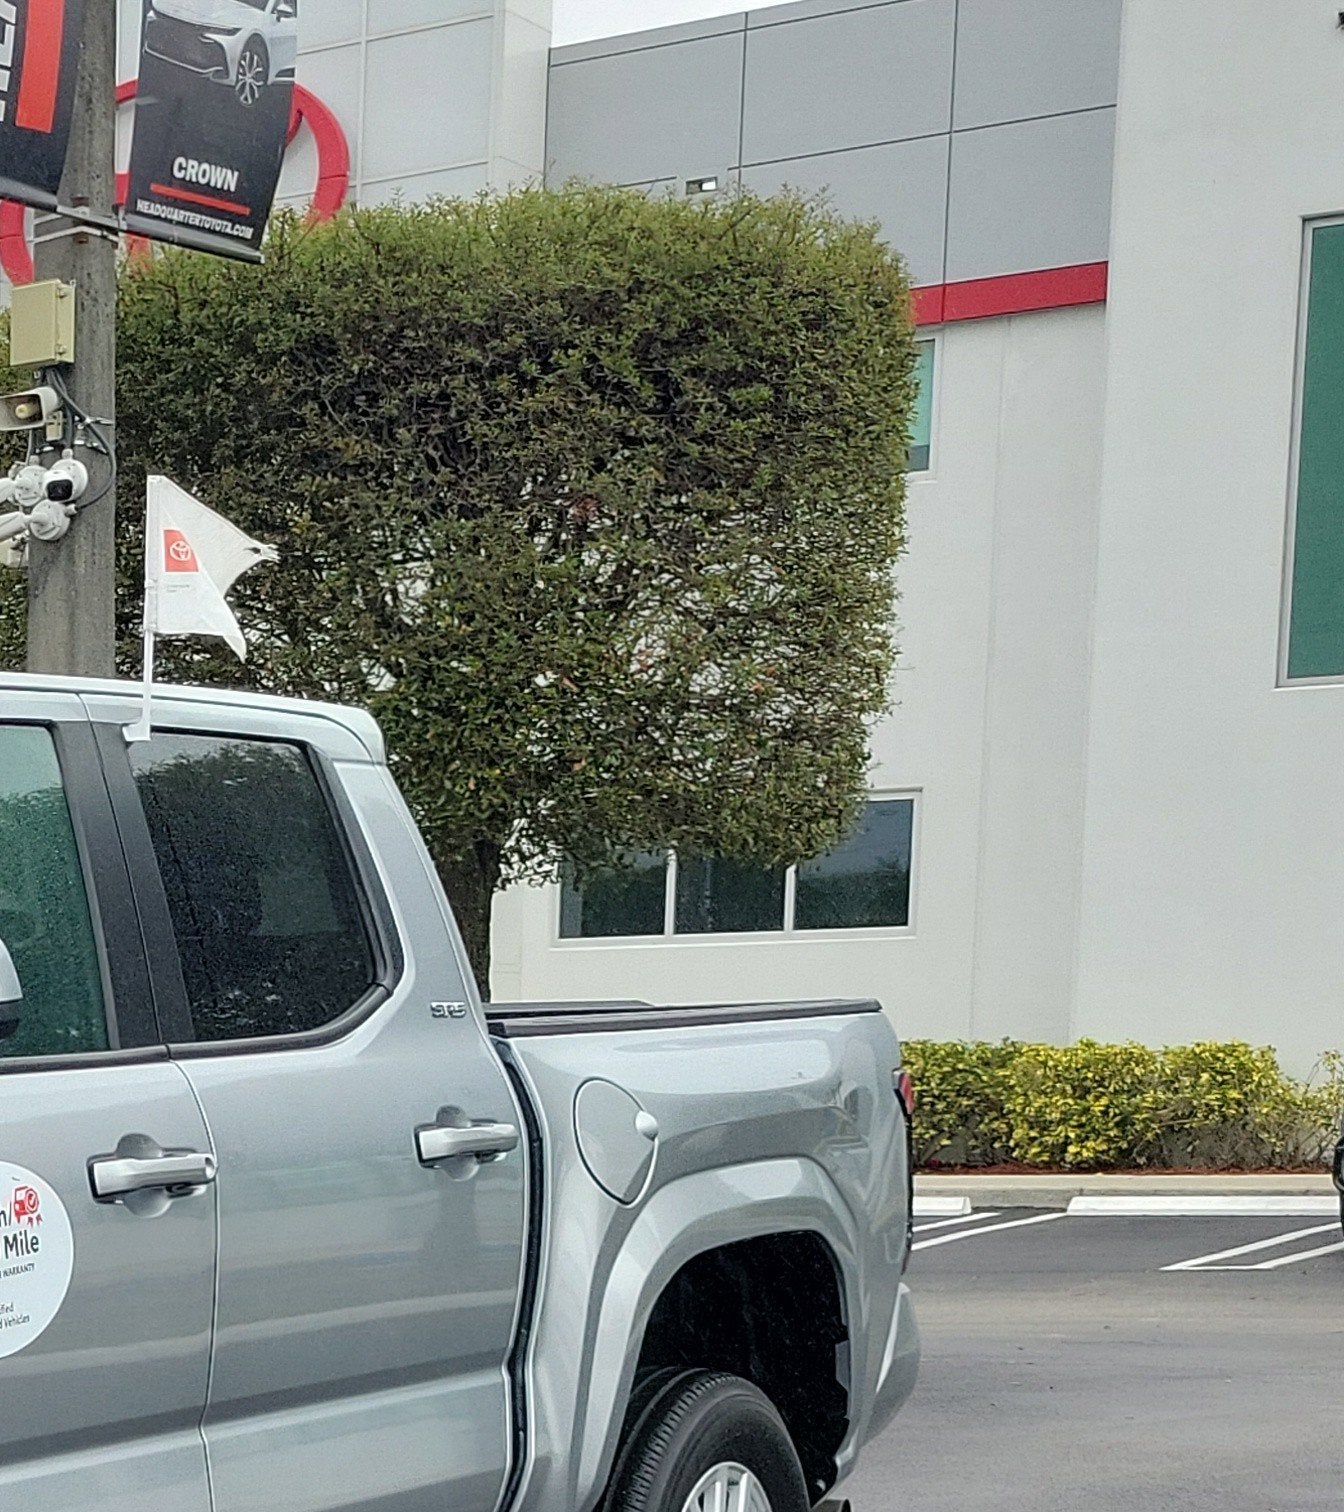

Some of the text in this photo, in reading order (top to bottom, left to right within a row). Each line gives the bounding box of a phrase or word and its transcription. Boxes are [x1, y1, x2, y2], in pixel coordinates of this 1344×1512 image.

[172, 156, 239, 193] CROWN
[136, 199, 254, 239] HEADQUARTERTOYOTA.COM
[3, 1230, 39, 1259] Mile
